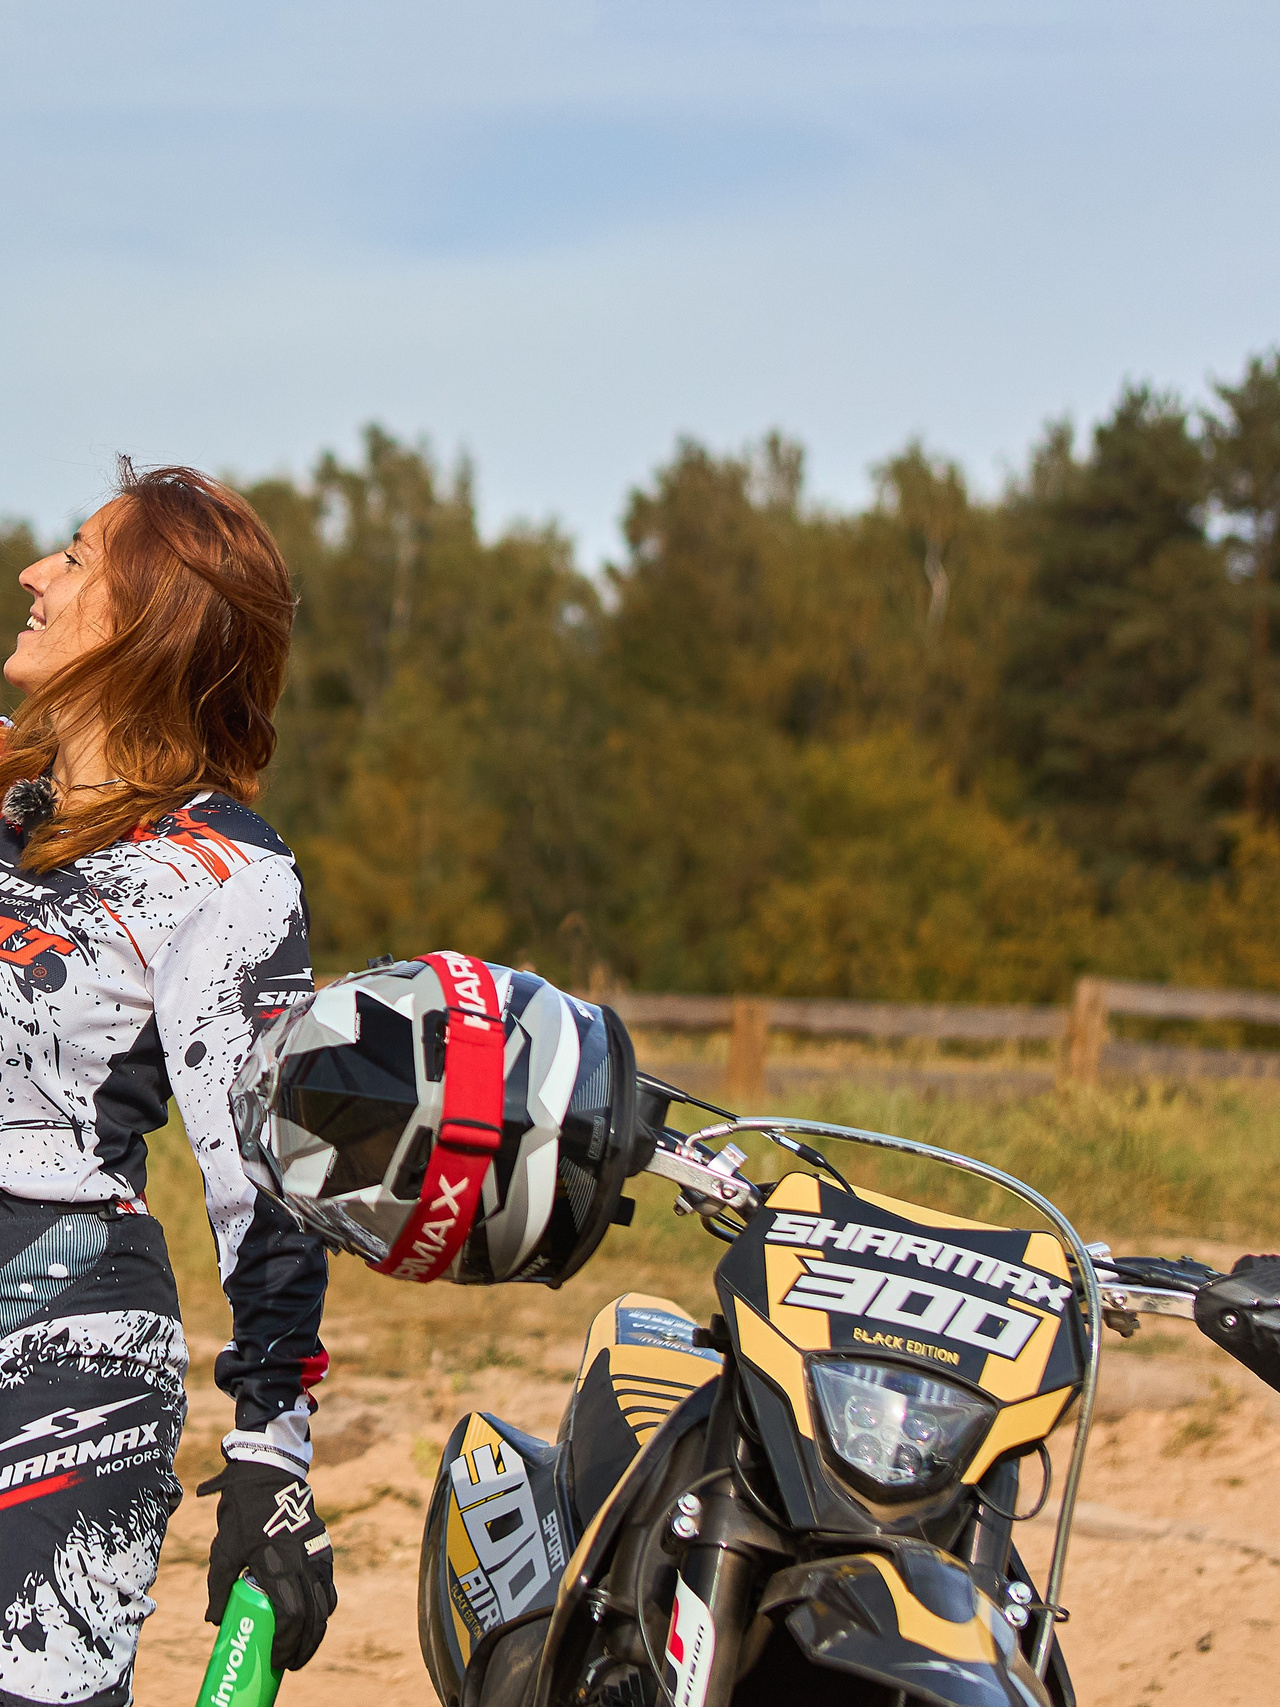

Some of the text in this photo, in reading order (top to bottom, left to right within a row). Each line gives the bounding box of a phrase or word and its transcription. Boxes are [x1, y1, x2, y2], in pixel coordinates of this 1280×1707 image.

[765, 1213, 1073, 1313] SHARMAX
[782, 1258, 1041, 1359] 300
[852, 1326, 961, 1366] BLACK EDITION
[96, 1448, 161, 1478] MOTORS
[450, 1440, 551, 1623] 300
[542, 1509, 566, 1573] SPORT
[210, 1616, 255, 1707] invoke
